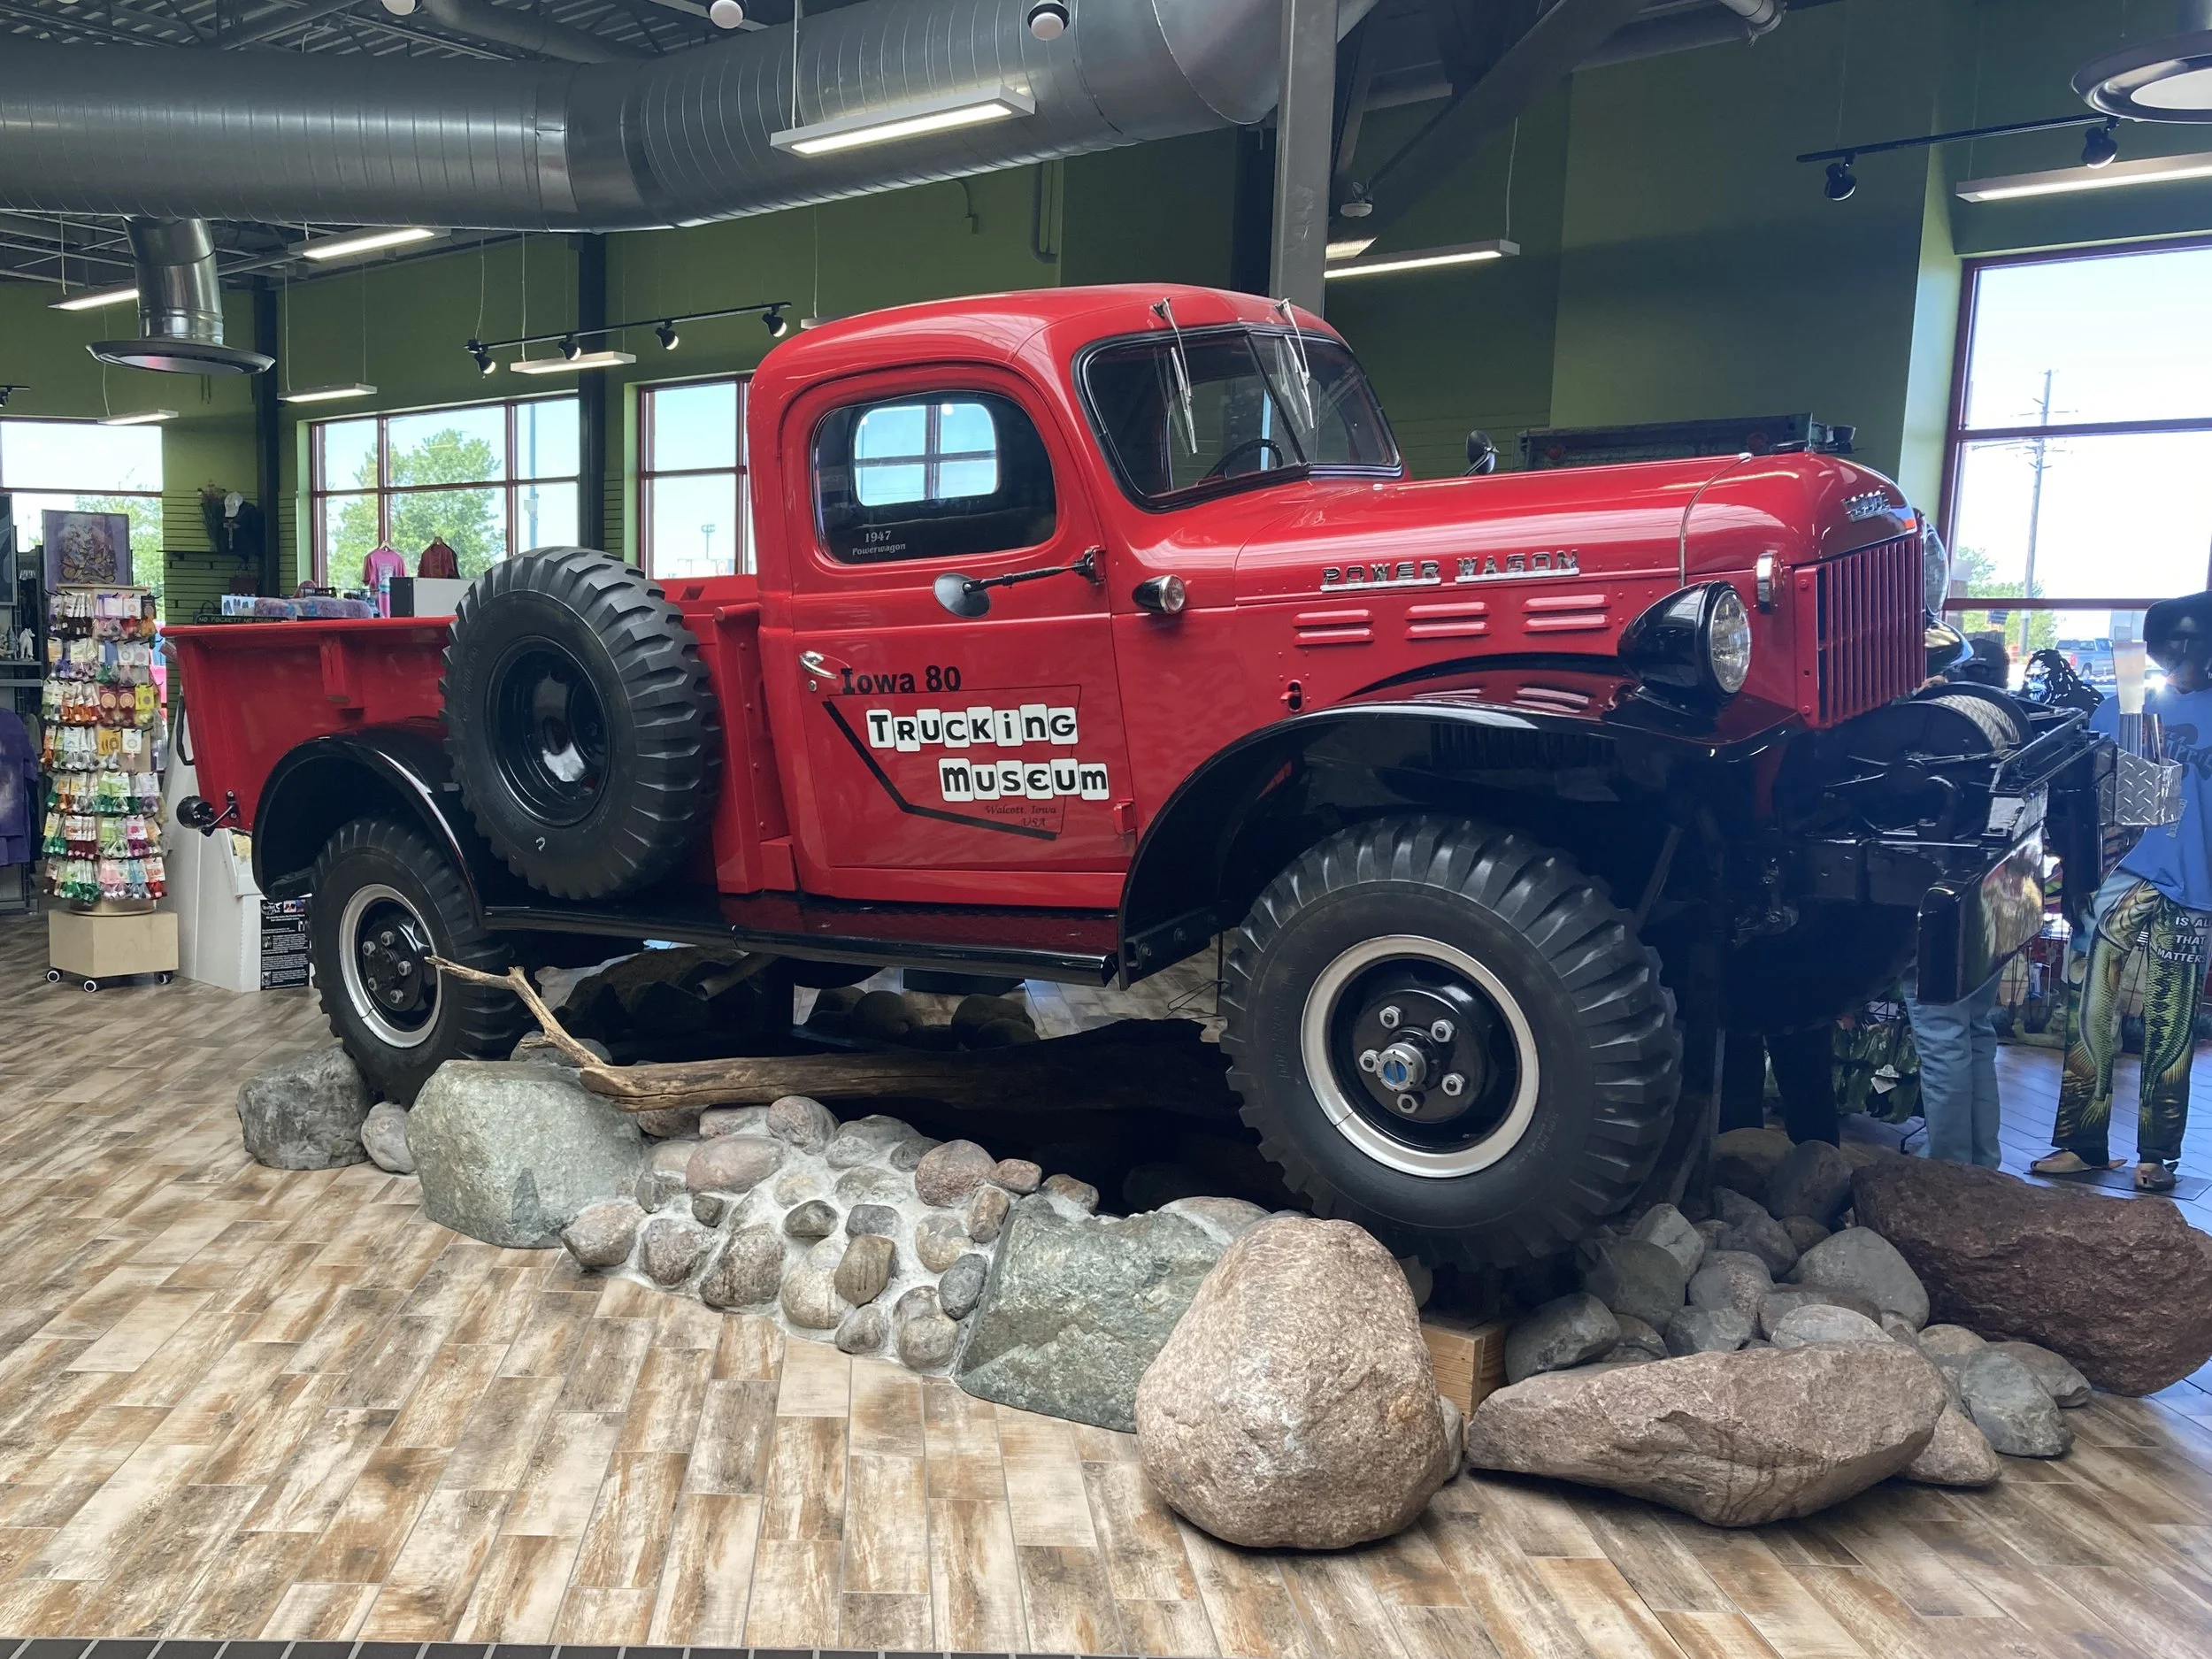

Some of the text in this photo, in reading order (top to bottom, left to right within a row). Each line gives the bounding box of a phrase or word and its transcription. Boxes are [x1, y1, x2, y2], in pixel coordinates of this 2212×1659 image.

[865, 530, 892, 542] 1947
[852, 543, 906, 556] Powerwagon
[1323, 549, 1578, 585] POWER WAGON
[841, 665, 962, 695] Iowa 80
[1031, 805, 1057, 814] Iowa
[1021, 817, 1047, 827] USA
[2175, 917, 2211, 928] IS AL
[2176, 934, 2206, 945] THAT
